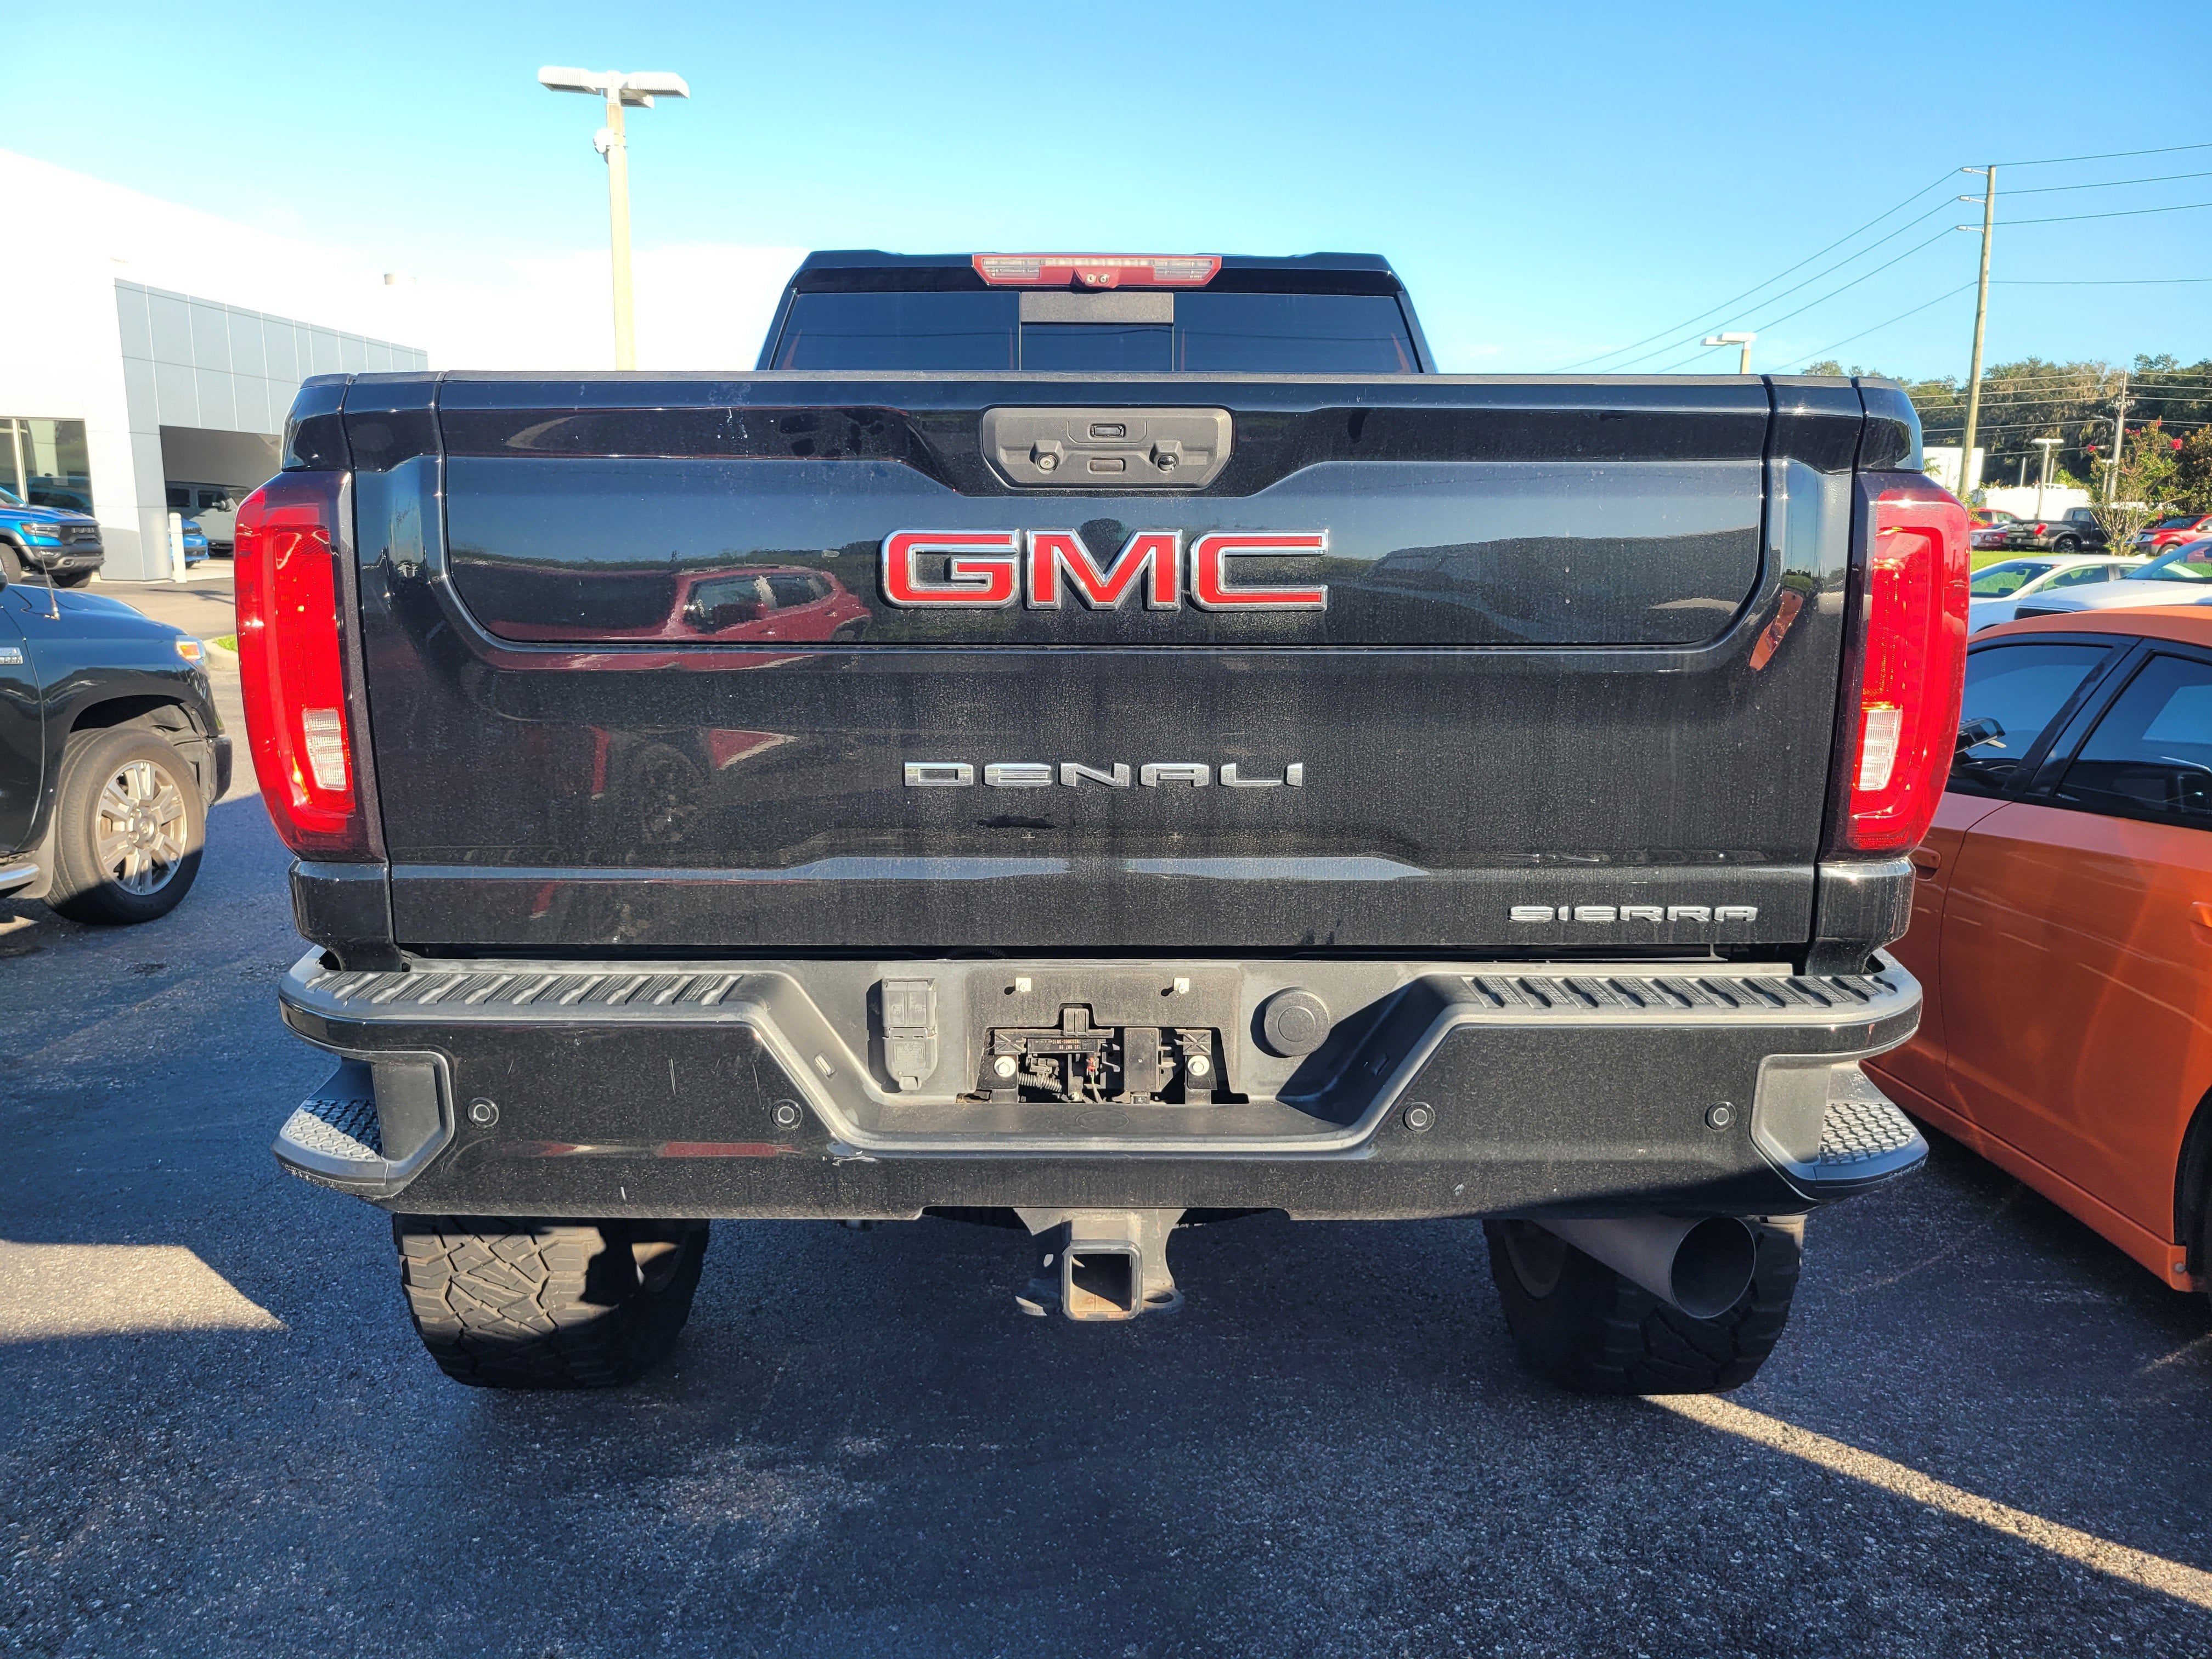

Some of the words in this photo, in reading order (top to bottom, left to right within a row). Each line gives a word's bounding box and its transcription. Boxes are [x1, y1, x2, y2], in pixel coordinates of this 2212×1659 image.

[881, 528, 1329, 612] GMC
[904, 761, 1304, 787] DENALI
[1508, 906, 1758, 922] SIERRA
